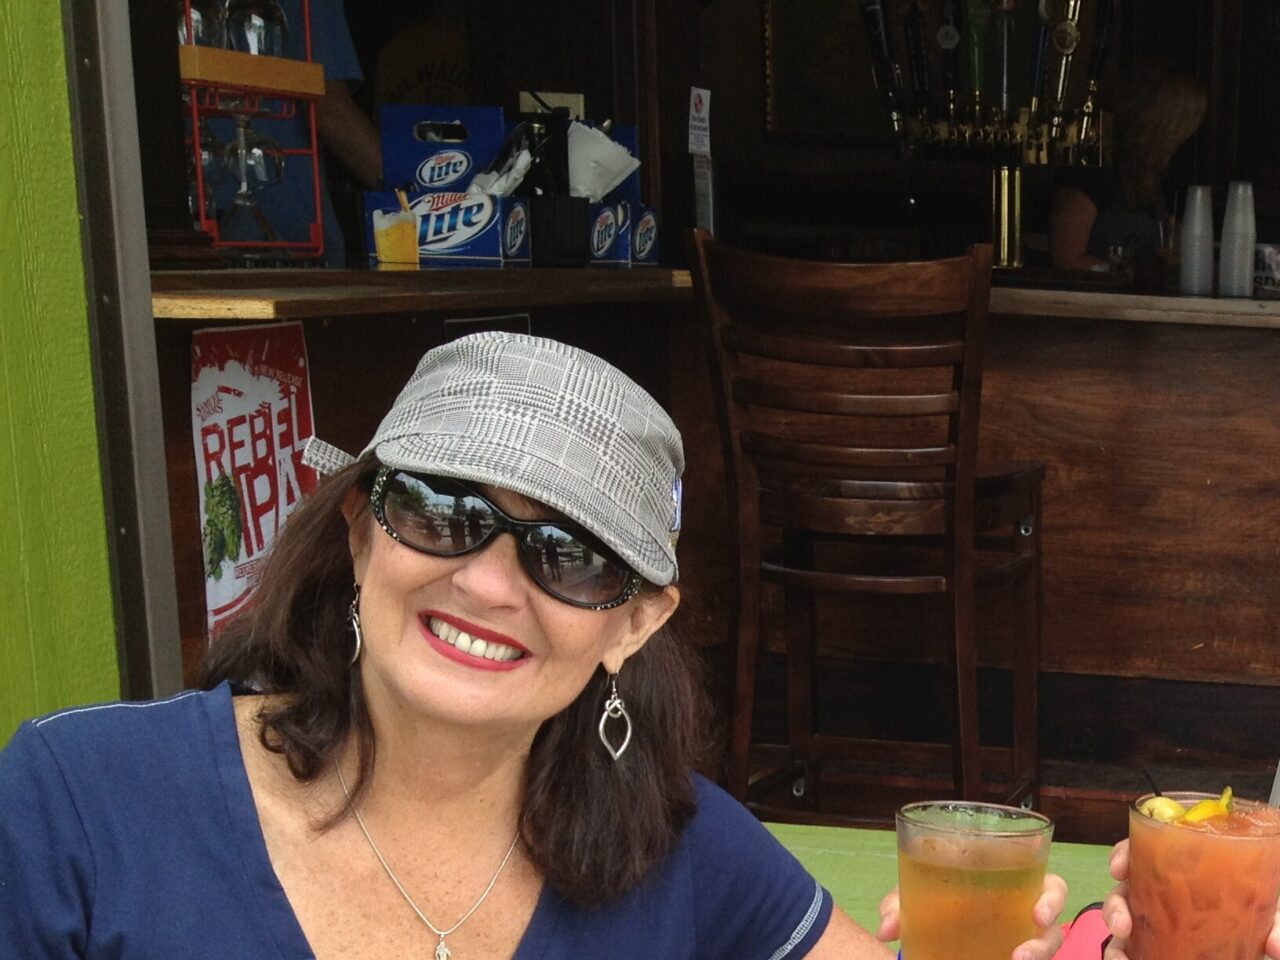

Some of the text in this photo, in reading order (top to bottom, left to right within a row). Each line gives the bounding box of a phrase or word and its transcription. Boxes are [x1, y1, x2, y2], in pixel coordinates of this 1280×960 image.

[428, 160, 464, 183] Lite
[424, 193, 471, 212] Miller
[418, 202, 485, 249] Lite
[276, 369, 303, 388] RELEASE
[201, 386, 311, 487] REBEL
[233, 449, 303, 558] IPA
